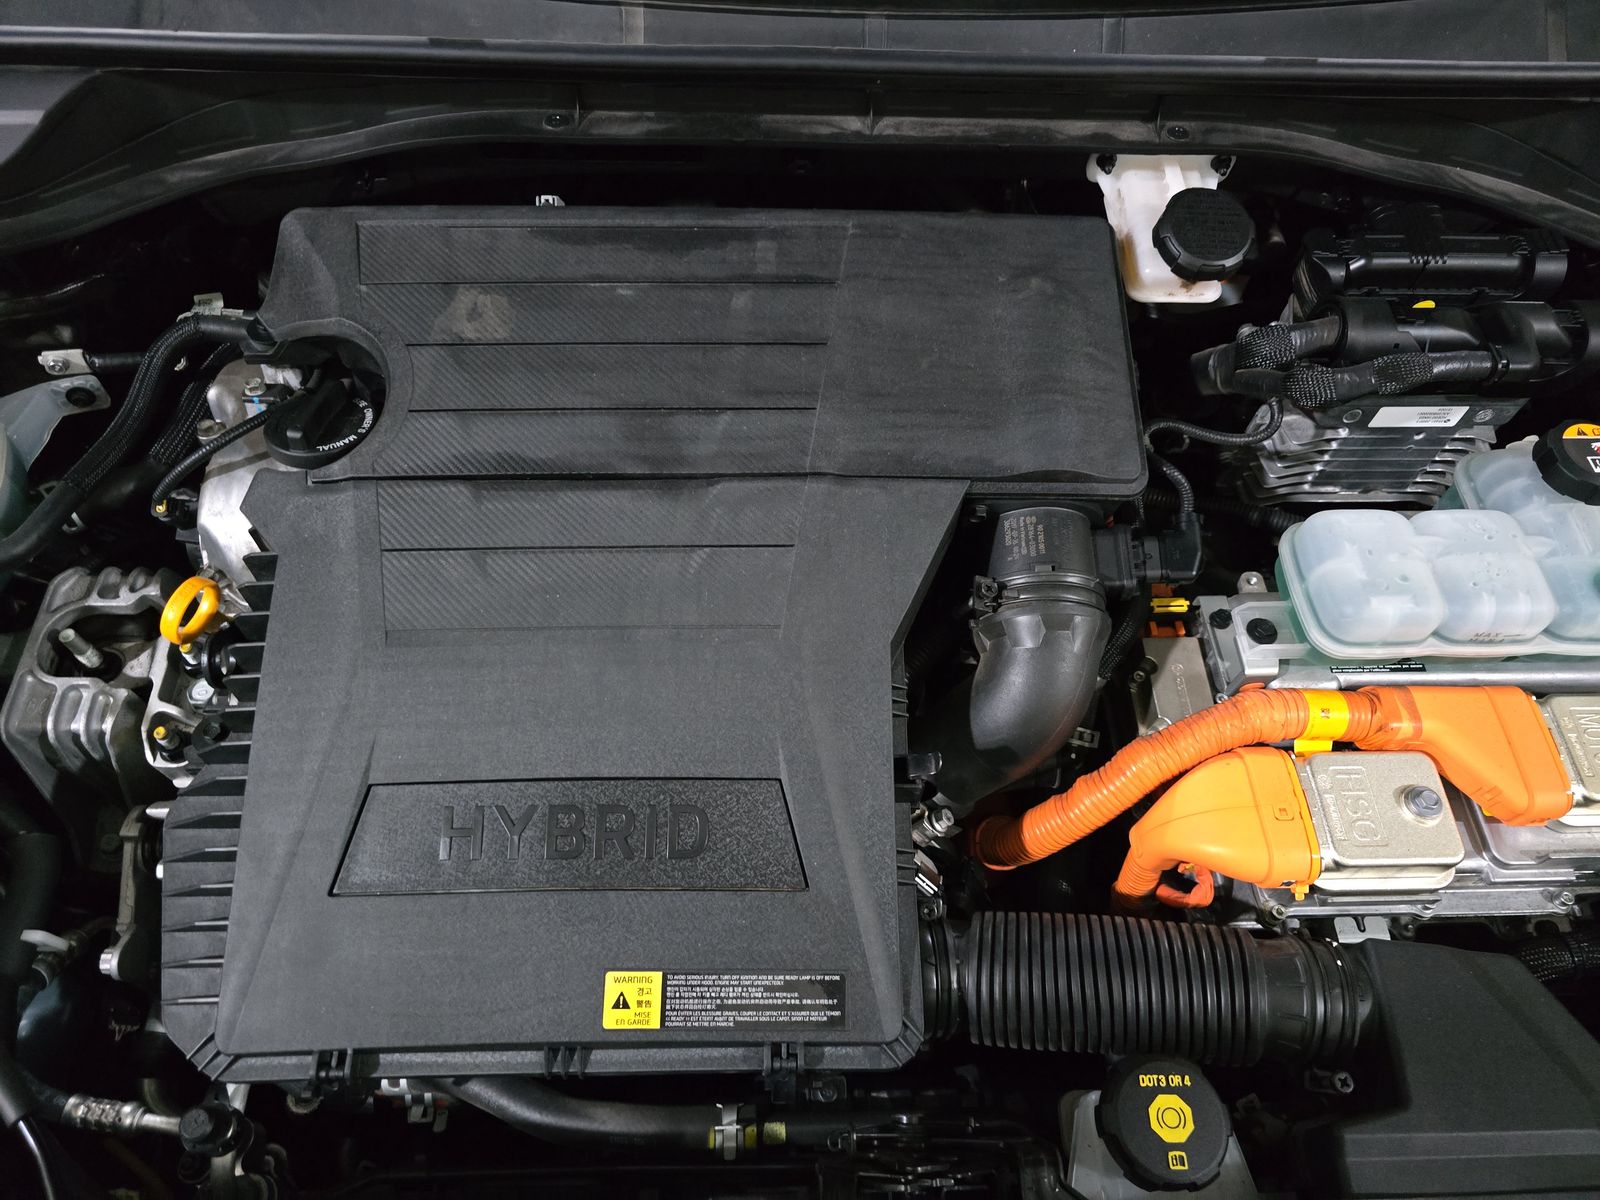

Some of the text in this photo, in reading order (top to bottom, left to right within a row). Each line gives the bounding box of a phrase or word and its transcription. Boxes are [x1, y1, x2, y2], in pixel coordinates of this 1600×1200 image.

[316, 434, 358, 452] MANUAL
[438, 804, 710, 861] HYBRID
[613, 976, 653, 984] WARNING
[637, 987, 652, 996] 경고
[1168, 1075, 1182, 1087] OR
[1184, 1075, 1191, 1087] 4
